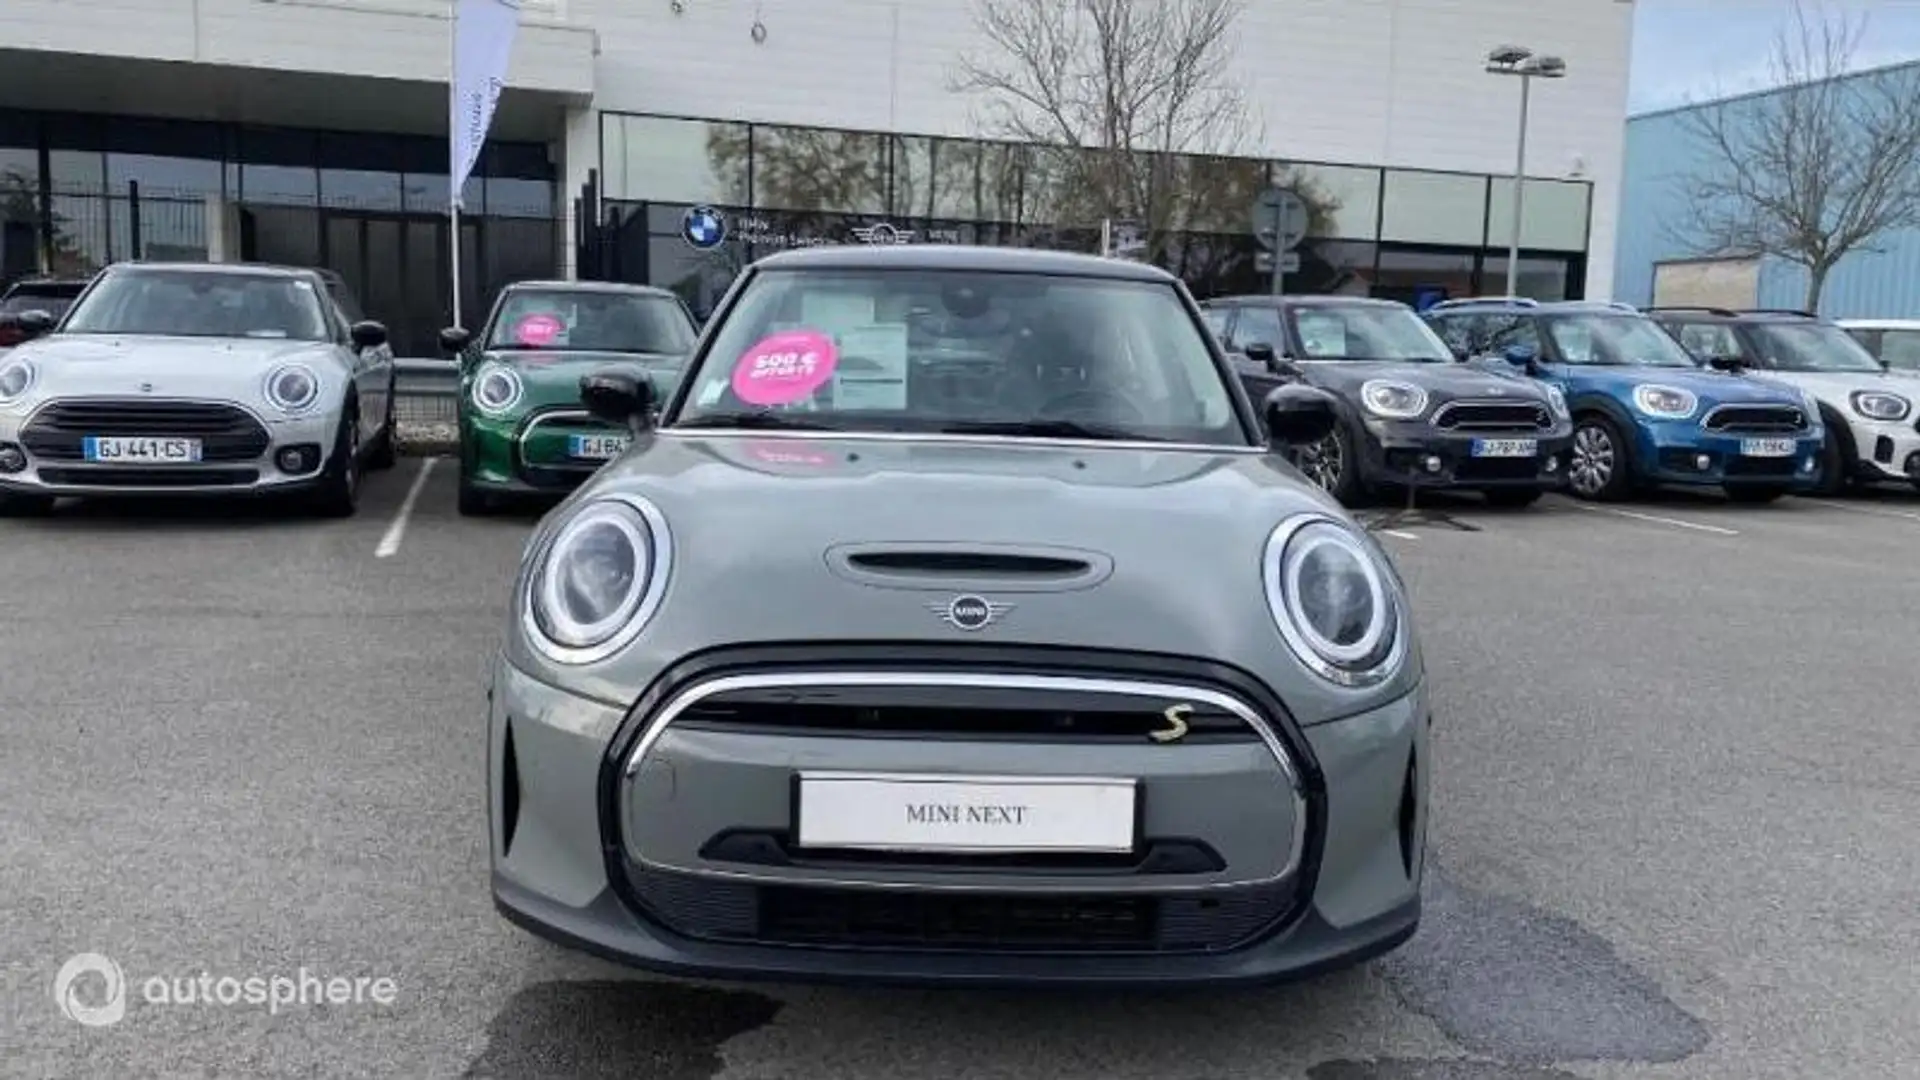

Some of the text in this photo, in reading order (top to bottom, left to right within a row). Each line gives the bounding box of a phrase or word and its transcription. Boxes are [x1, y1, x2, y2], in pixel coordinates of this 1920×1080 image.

[955, 606, 986, 617] MINI
[1150, 703, 1194, 742] S
[905, 804, 1028, 825] MINI NEXT
